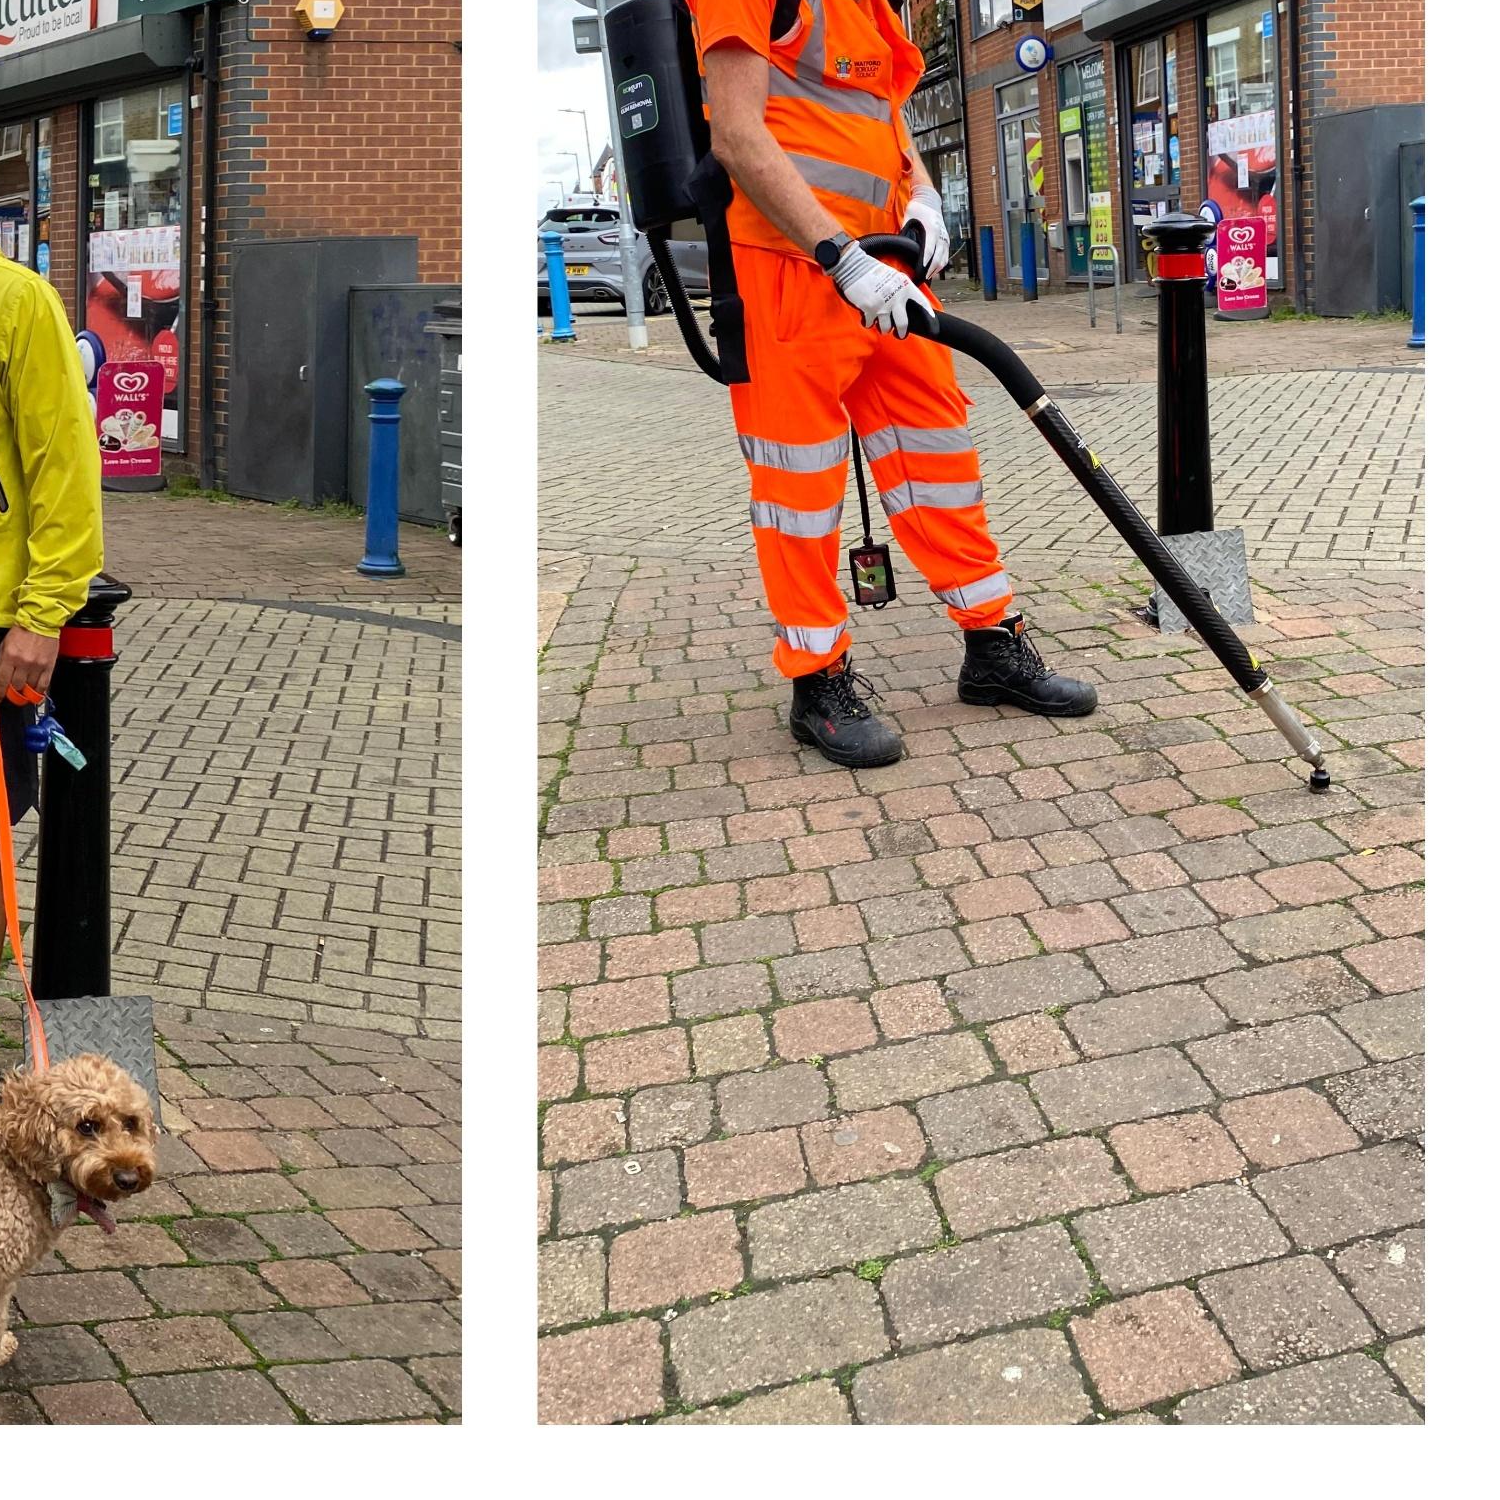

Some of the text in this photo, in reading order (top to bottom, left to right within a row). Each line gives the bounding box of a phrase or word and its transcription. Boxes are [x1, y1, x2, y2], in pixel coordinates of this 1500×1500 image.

[19, 6, 83, 42] Proud to be local
[1081, 60, 1105, 80] WELCOME
[630, 97, 653, 111] REMOVAL
[114, 392, 146, 402] WALL'S
